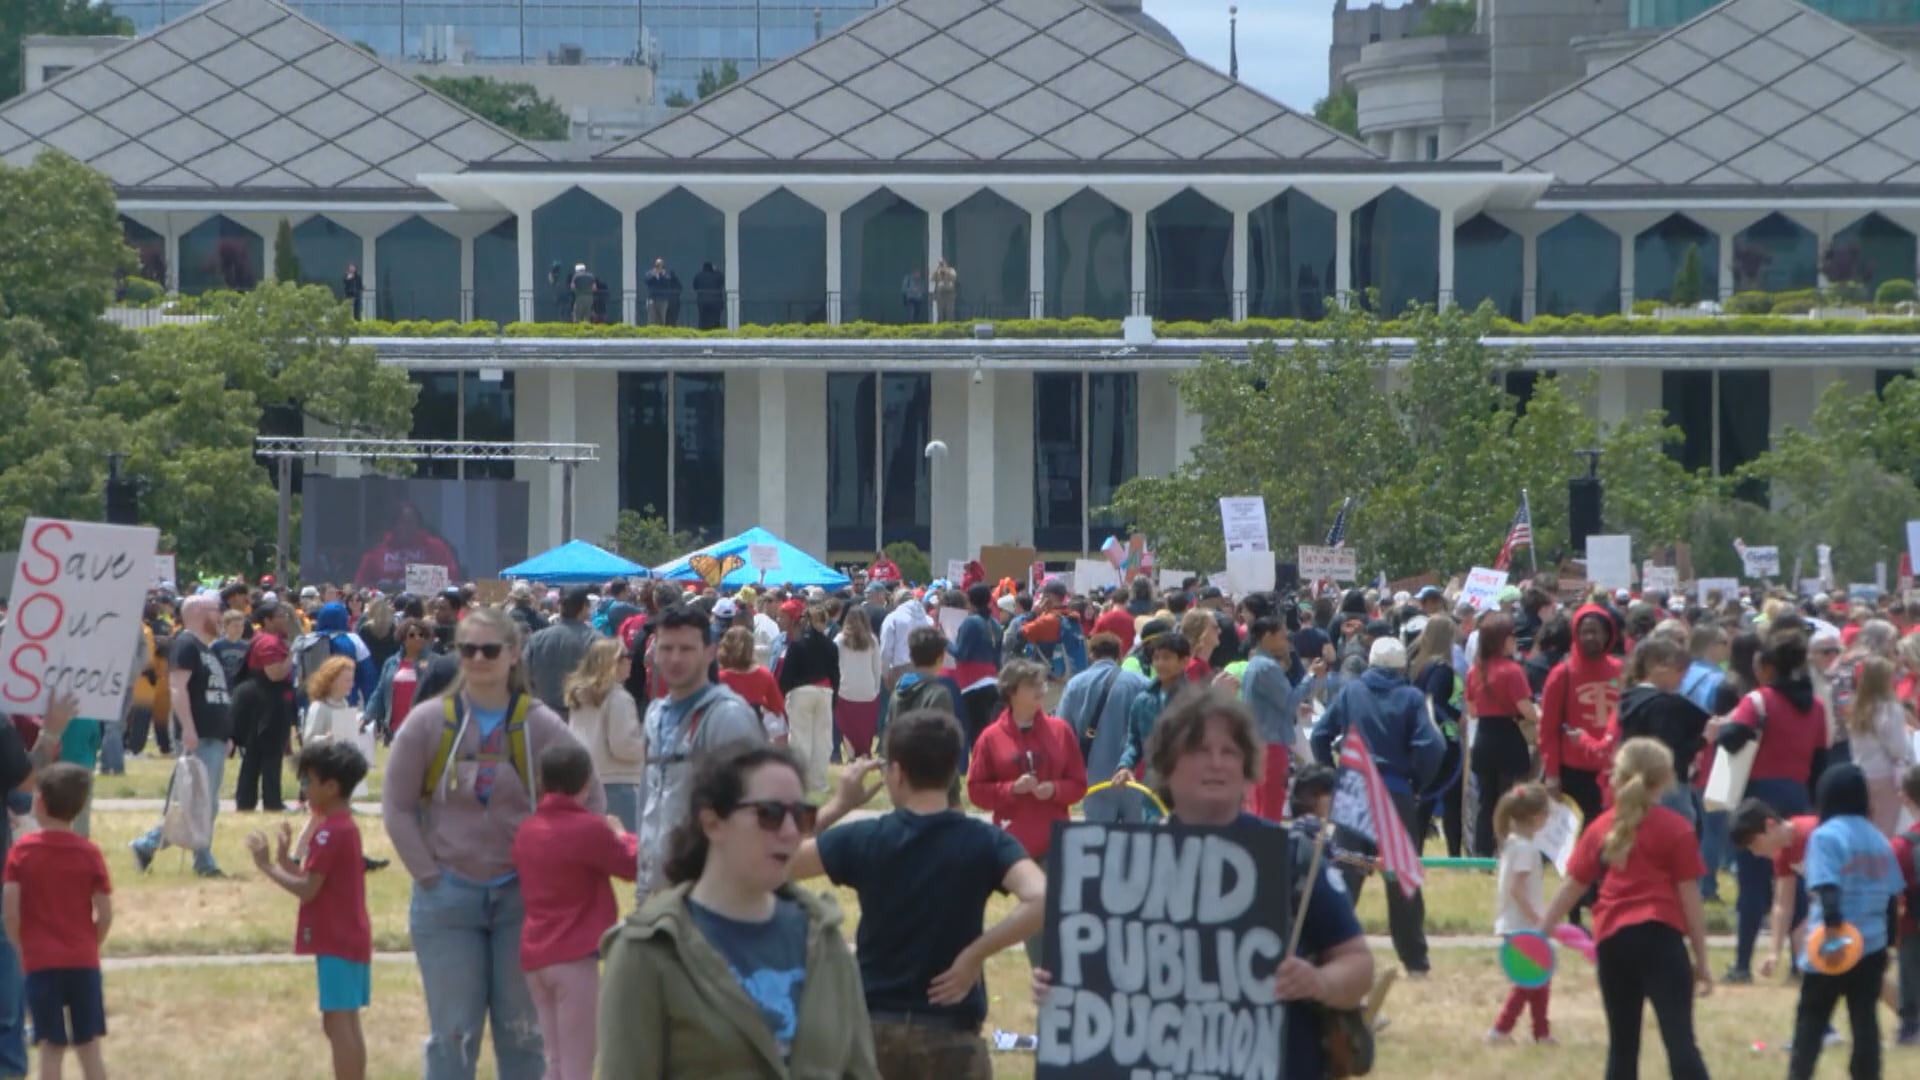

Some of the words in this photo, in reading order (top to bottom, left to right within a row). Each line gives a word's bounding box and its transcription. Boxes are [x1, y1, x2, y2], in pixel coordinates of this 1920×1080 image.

[21, 522, 135, 586] Save
[16, 592, 120, 641] Our
[2, 642, 122, 703] Schools
[1059, 824, 1258, 925] FUND
[1058, 913, 1282, 1005] PUBLIC
[1037, 985, 1283, 1080] EDUCATION
